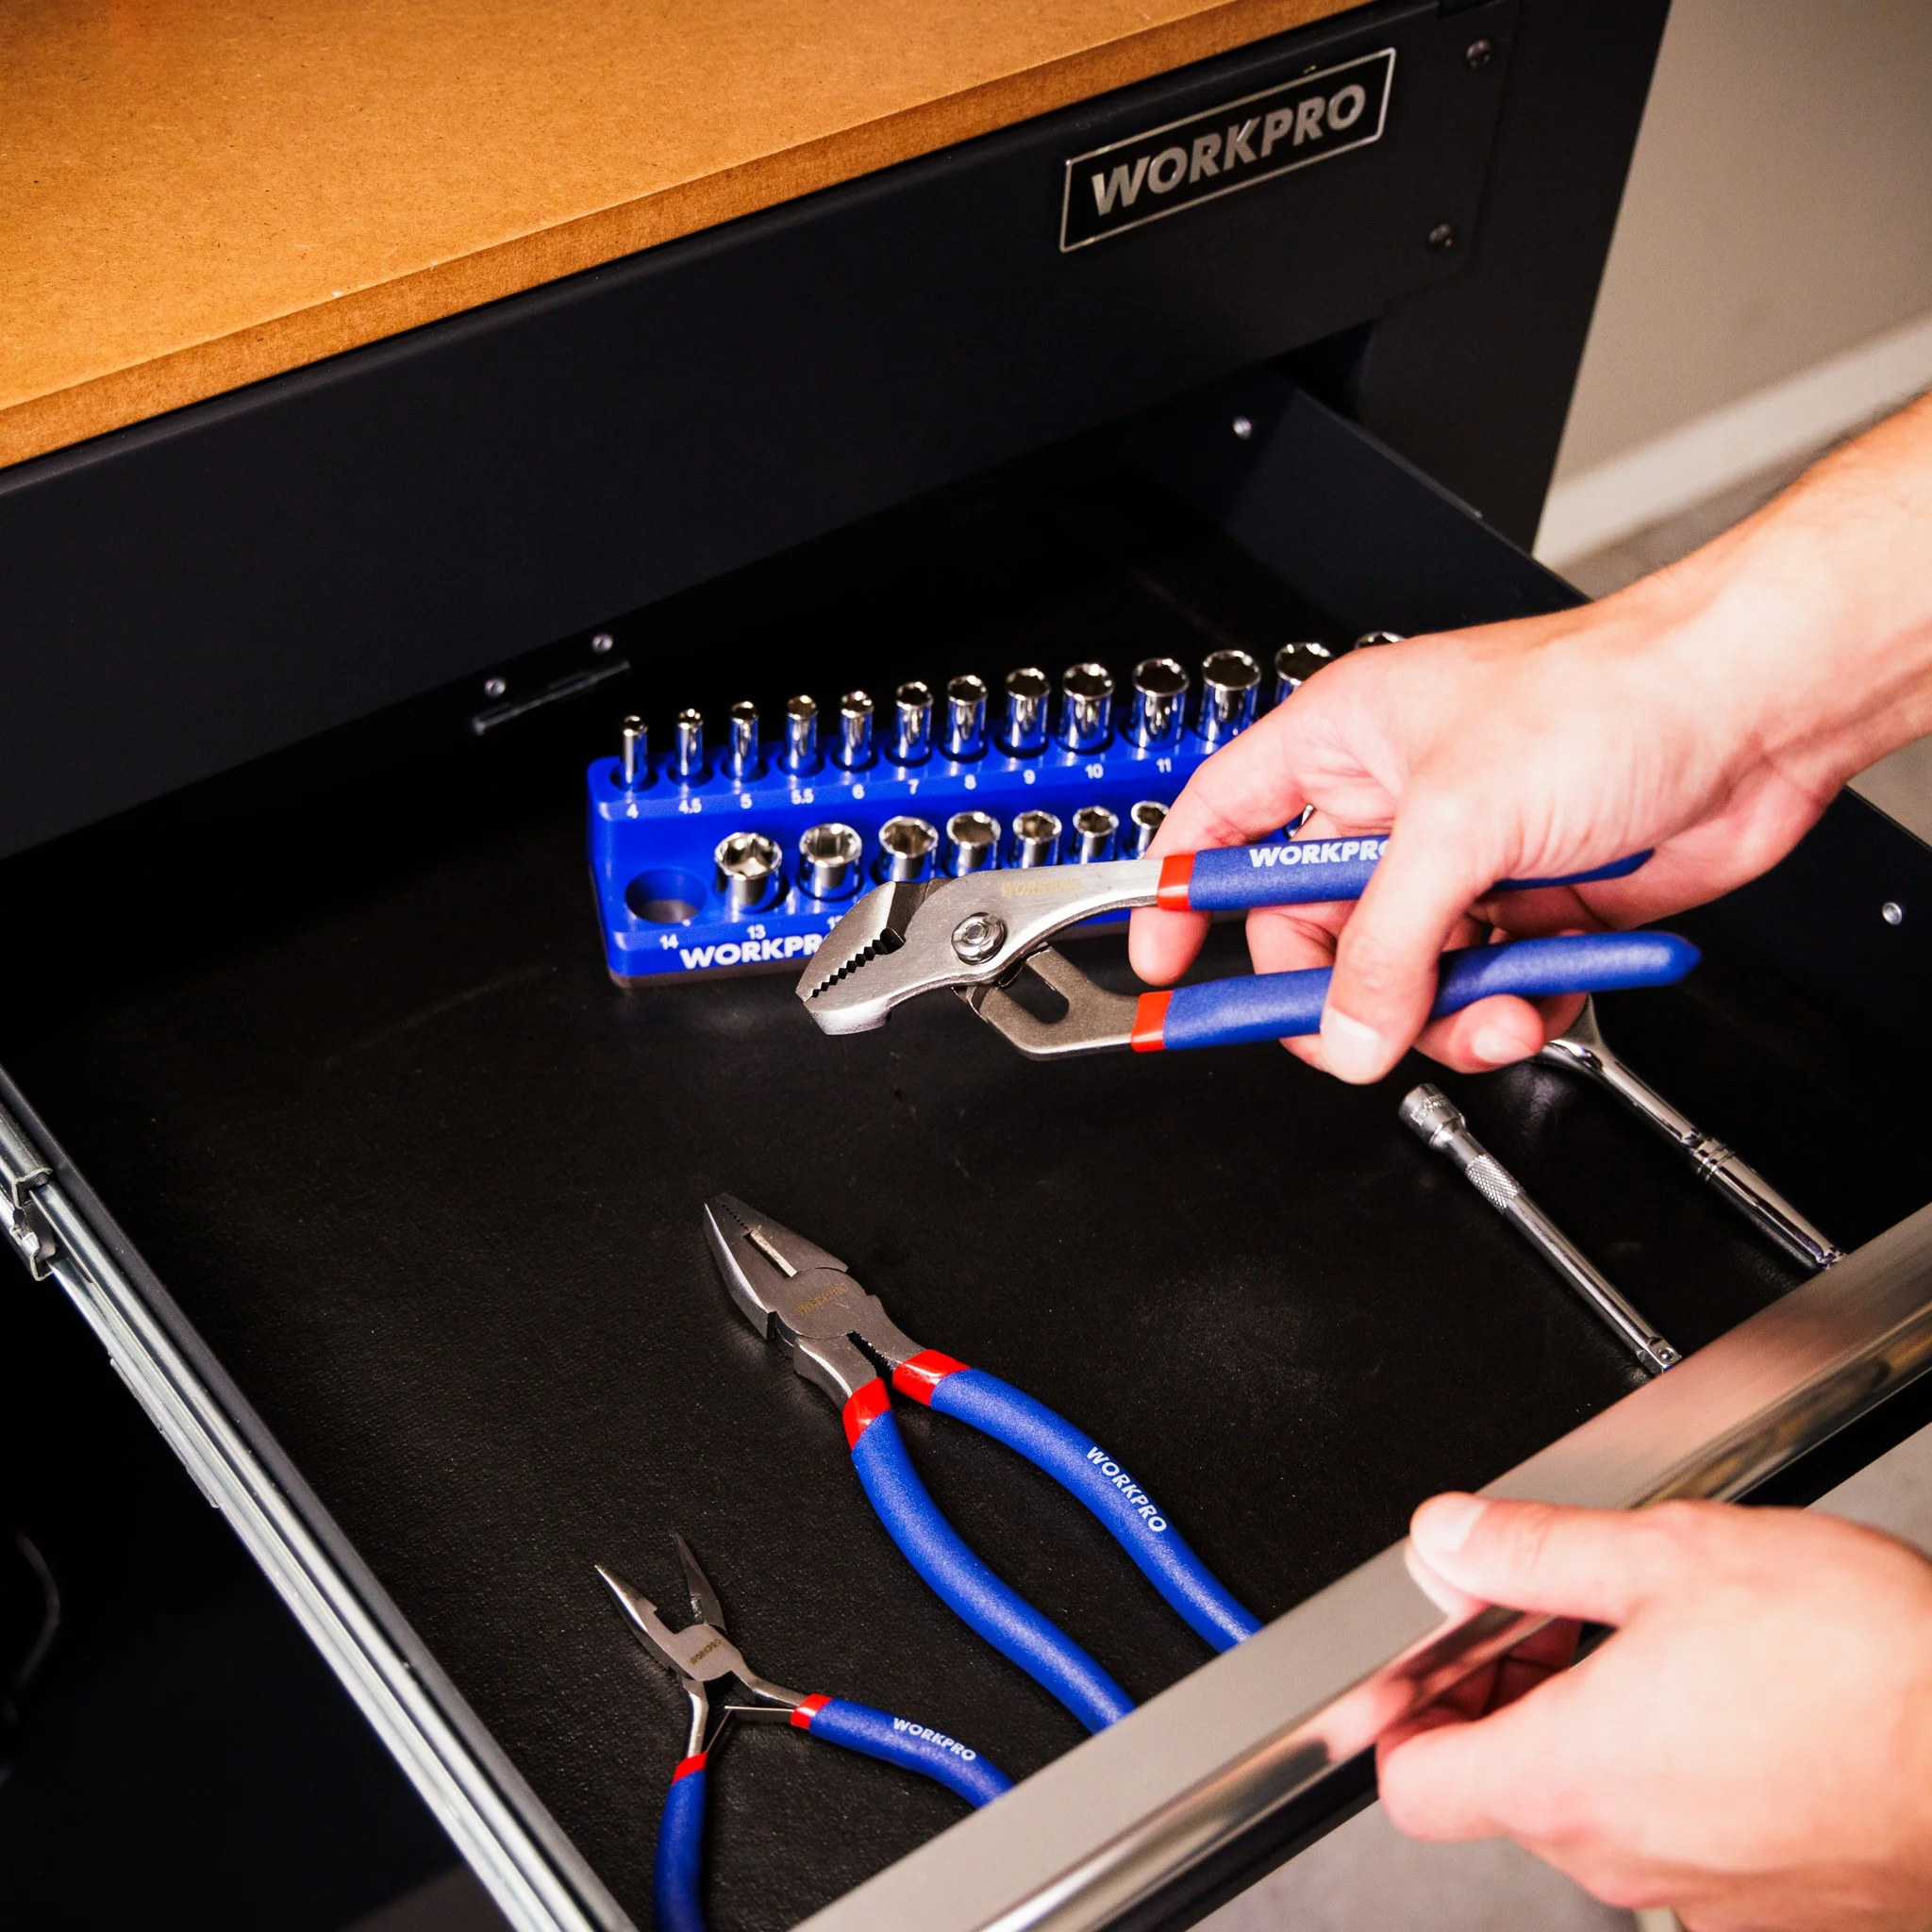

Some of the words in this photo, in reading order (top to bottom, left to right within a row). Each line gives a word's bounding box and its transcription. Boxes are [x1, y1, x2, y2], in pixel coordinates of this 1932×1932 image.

[1091, 84, 1366, 216] WORKPRO
[626, 804, 639, 819] 4
[678, 799, 702, 813] 4.5
[741, 793, 753, 809] 5
[791, 787, 815, 805] 5.5
[852, 783, 865, 800] 6
[908, 778, 920, 795] 7
[964, 774, 977, 791] 8
[1024, 769, 1036, 785] 9
[1085, 763, 1104, 779] 10
[1156, 758, 1172, 774] 11
[659, 934, 679, 951] 14
[746, 924, 766, 941] 13
[679, 933, 824, 970] WORKPR
[1086, 1446, 1167, 1532] WORKPRO
[892, 1717, 976, 1761] WORKPRO
